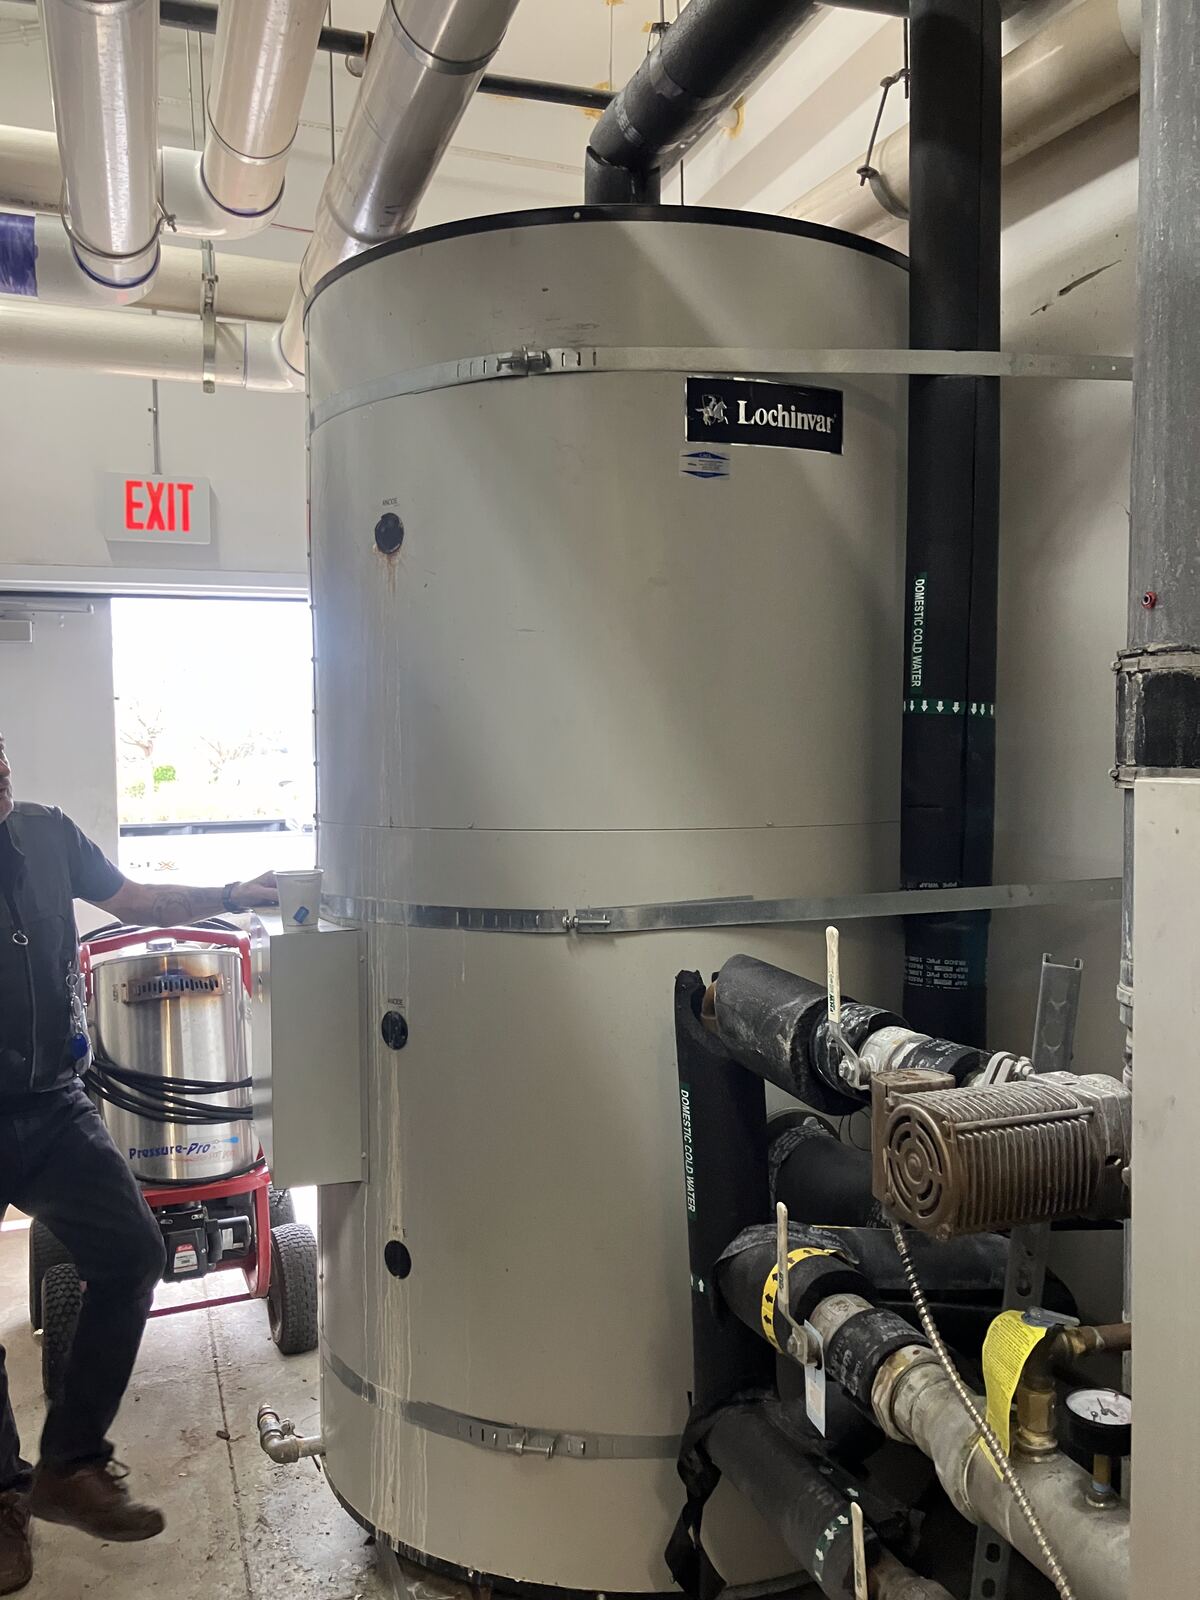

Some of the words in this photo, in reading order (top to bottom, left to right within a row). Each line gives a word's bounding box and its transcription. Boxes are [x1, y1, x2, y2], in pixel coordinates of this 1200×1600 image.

[737, 400, 835, 433] Lochinvar
[125, 480, 193, 532] EXIT
[913, 578, 925, 626] DOMESTIC
[912, 628, 923, 653] COLD
[911, 655, 922, 687] WATER
[680, 1088, 692, 1143] DOMESTIC
[129, 1142, 211, 1159] Pressure-Pro
[684, 1145, 694, 1174] COLD
[686, 1176, 696, 1212] WATER
